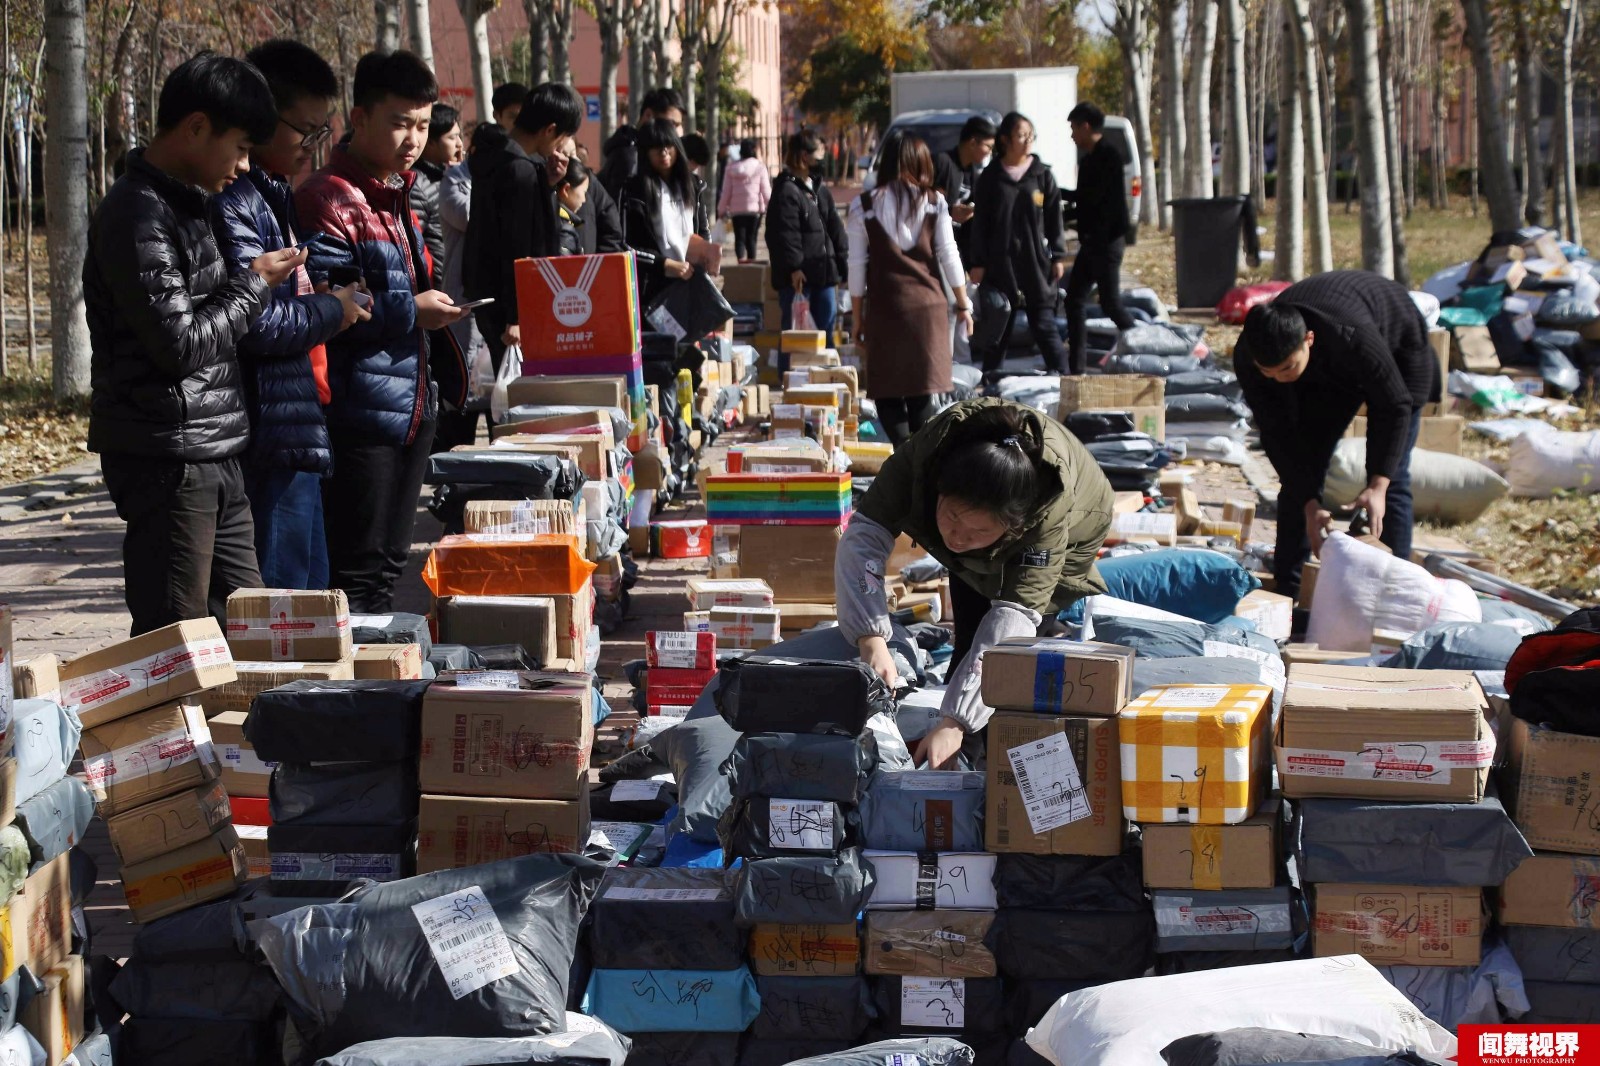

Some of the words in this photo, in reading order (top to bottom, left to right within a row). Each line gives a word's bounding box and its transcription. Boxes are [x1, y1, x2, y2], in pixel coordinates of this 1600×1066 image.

[1094, 727, 1110, 781] SUPOR
[1093, 787, 1107, 827] 苏泊尔
